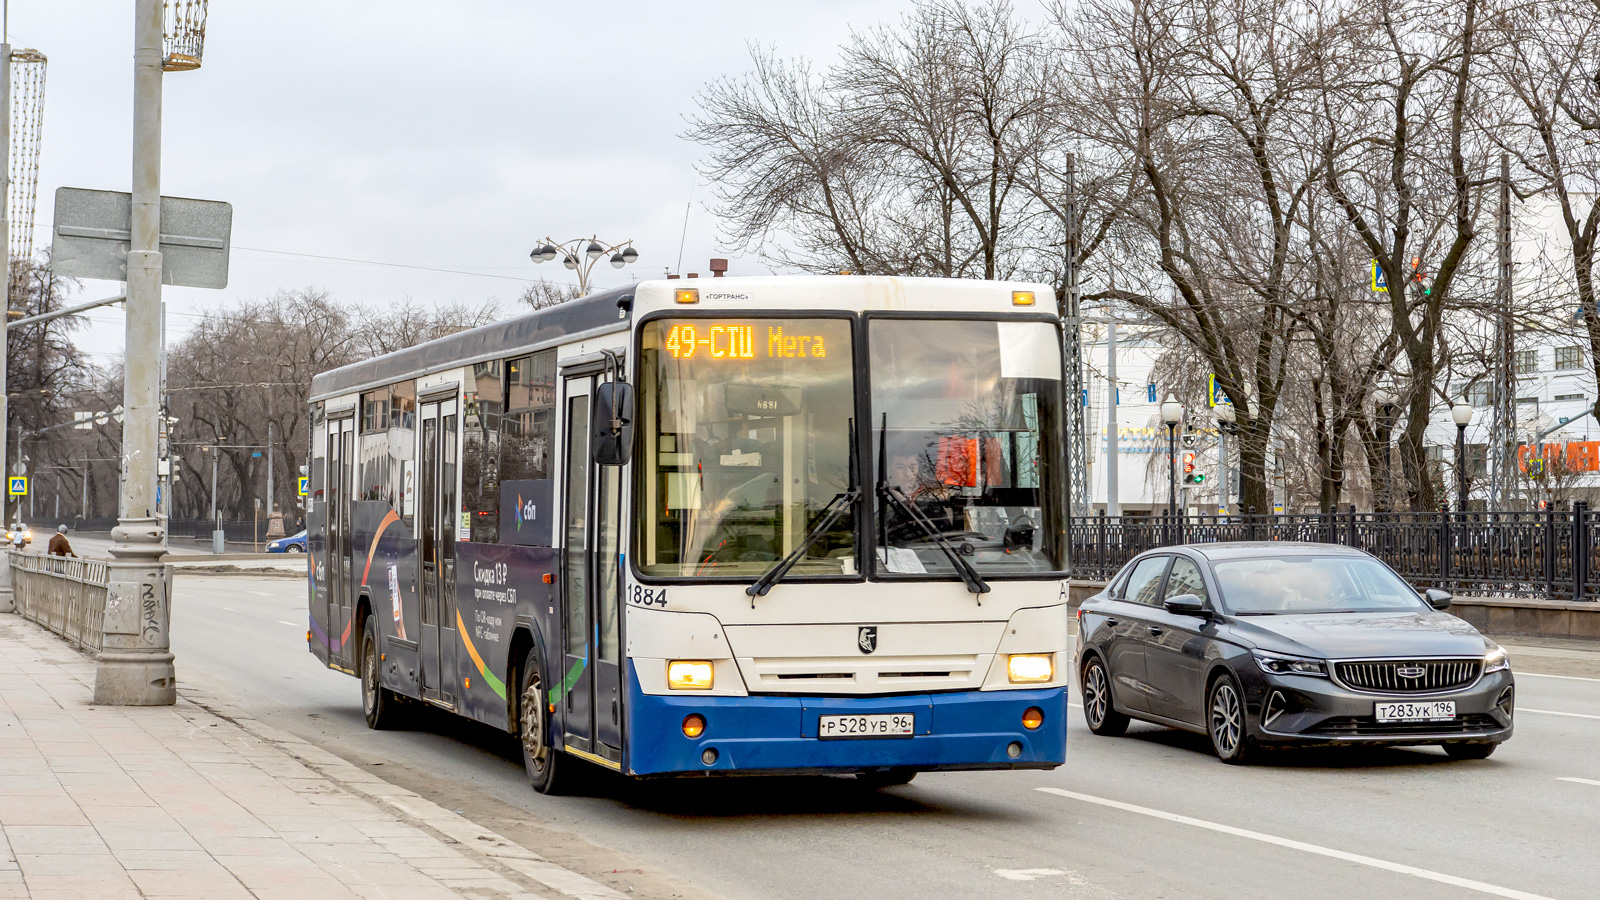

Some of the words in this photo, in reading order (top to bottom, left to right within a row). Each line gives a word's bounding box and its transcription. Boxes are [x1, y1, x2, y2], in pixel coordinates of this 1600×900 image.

[768, 326, 827, 358] Мега
[757, 400, 777, 410] 1884
[523, 499, 536, 520] сбп
[474, 560, 495, 586] Скидка
[495, 562, 502, 585] 13
[474, 588, 482, 602] при
[482, 589, 495, 601] оплате
[495, 591, 507, 605] через
[506, 587, 517, 604] СБП
[628, 583, 668, 608] 1884
[1380, 704, 1431, 718] Т283УК
[1433, 702, 1453, 713] 196
[892, 716, 908, 728] 96
